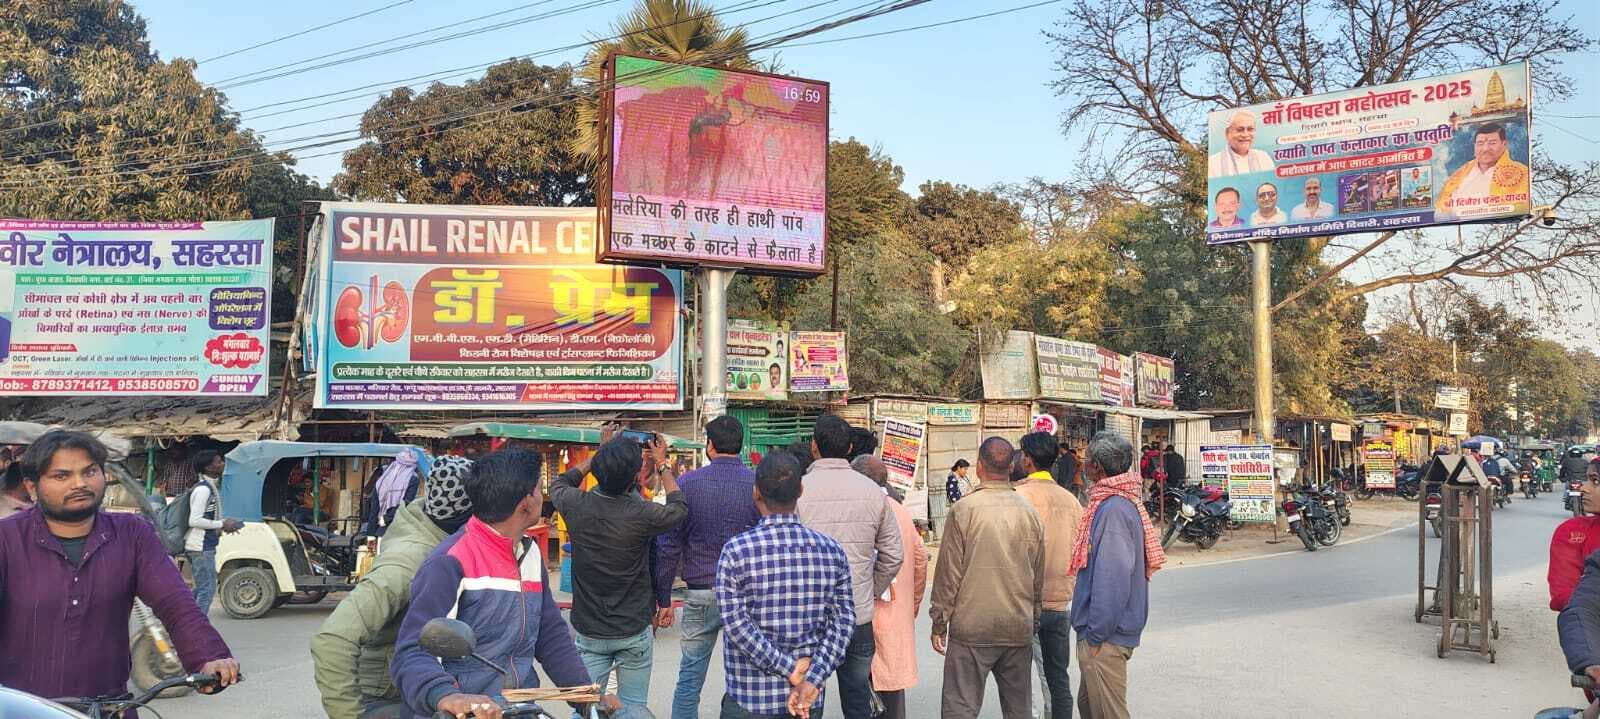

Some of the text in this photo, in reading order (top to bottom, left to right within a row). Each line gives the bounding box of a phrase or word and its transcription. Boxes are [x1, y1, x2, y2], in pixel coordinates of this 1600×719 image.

[784, 87, 821, 104] 16:59
[1262, 80, 1472, 125] माँ विषहरा महोत्सव- 2025
[1274, 126, 1452, 161] ख्याति प्राप्त कलाकार का प्रस्तुति
[1280, 164, 1315, 176] महोत्सव
[1316, 161, 1326, 172] में
[1328, 160, 1346, 171] आप
[1349, 157, 1374, 168] सादर
[1377, 151, 1415, 166] आमंत्रित
[613, 194, 804, 232] मलेरिया की तरह ही हाथी पांव
[1278, 224, 1310, 236] निर्माण
[1312, 221, 1344, 233] समिति
[1383, 215, 1421, 227] सहरसा
[341, 216, 437, 253] SHAIL
[447, 218, 547, 255] RENAL
[0, 232, 264, 270] वीर नेत्रालय, सहरसा
[613, 232, 633, 249] एक
[641, 234, 676, 252] मच्छर
[684, 231, 696, 252] के
[705, 236, 738, 257] काटने
[747, 238, 758, 259] से
[766, 240, 801, 263] फैलता
[66, 292, 80, 303] एवं
[83, 292, 106, 303] कोशी
[111, 292, 127, 304] क्षेत्र
[131, 292, 139, 303] में
[161, 292, 184, 304] पहली
[430, 268, 659, 327] डॉ. प्रेम
[43, 307, 51, 318] के
[76, 309, 117, 319] (Retina)
[155, 309, 192, 319] (Nerve)
[77, 324, 88, 333] का
[12, 355, 29, 363] OCT,
[150, 355, 187, 363] Injections
[459, 348, 490, 358] किडनी
[492, 348, 509, 358] रोग
[510, 348, 544, 358] विशेषज्ञ
[546, 347, 560, 358] एवं
[211, 375, 255, 383] SUNDAY
[337, 366, 360, 377] प्रत्येक
[361, 366, 375, 377] माह
[376, 366, 384, 377] के
[429, 366, 452, 377] रविवार
[453, 366, 464, 377] को
[464, 366, 488, 377] सहरसा
[489, 366, 499, 377] में
[516, 366, 536, 377] देखते
[622, 366, 641, 377] देखते
[32, 379, 112, 391] 8789371412,
[117, 379, 197, 390] 9538508570
[219, 384, 247, 392] OPEN
